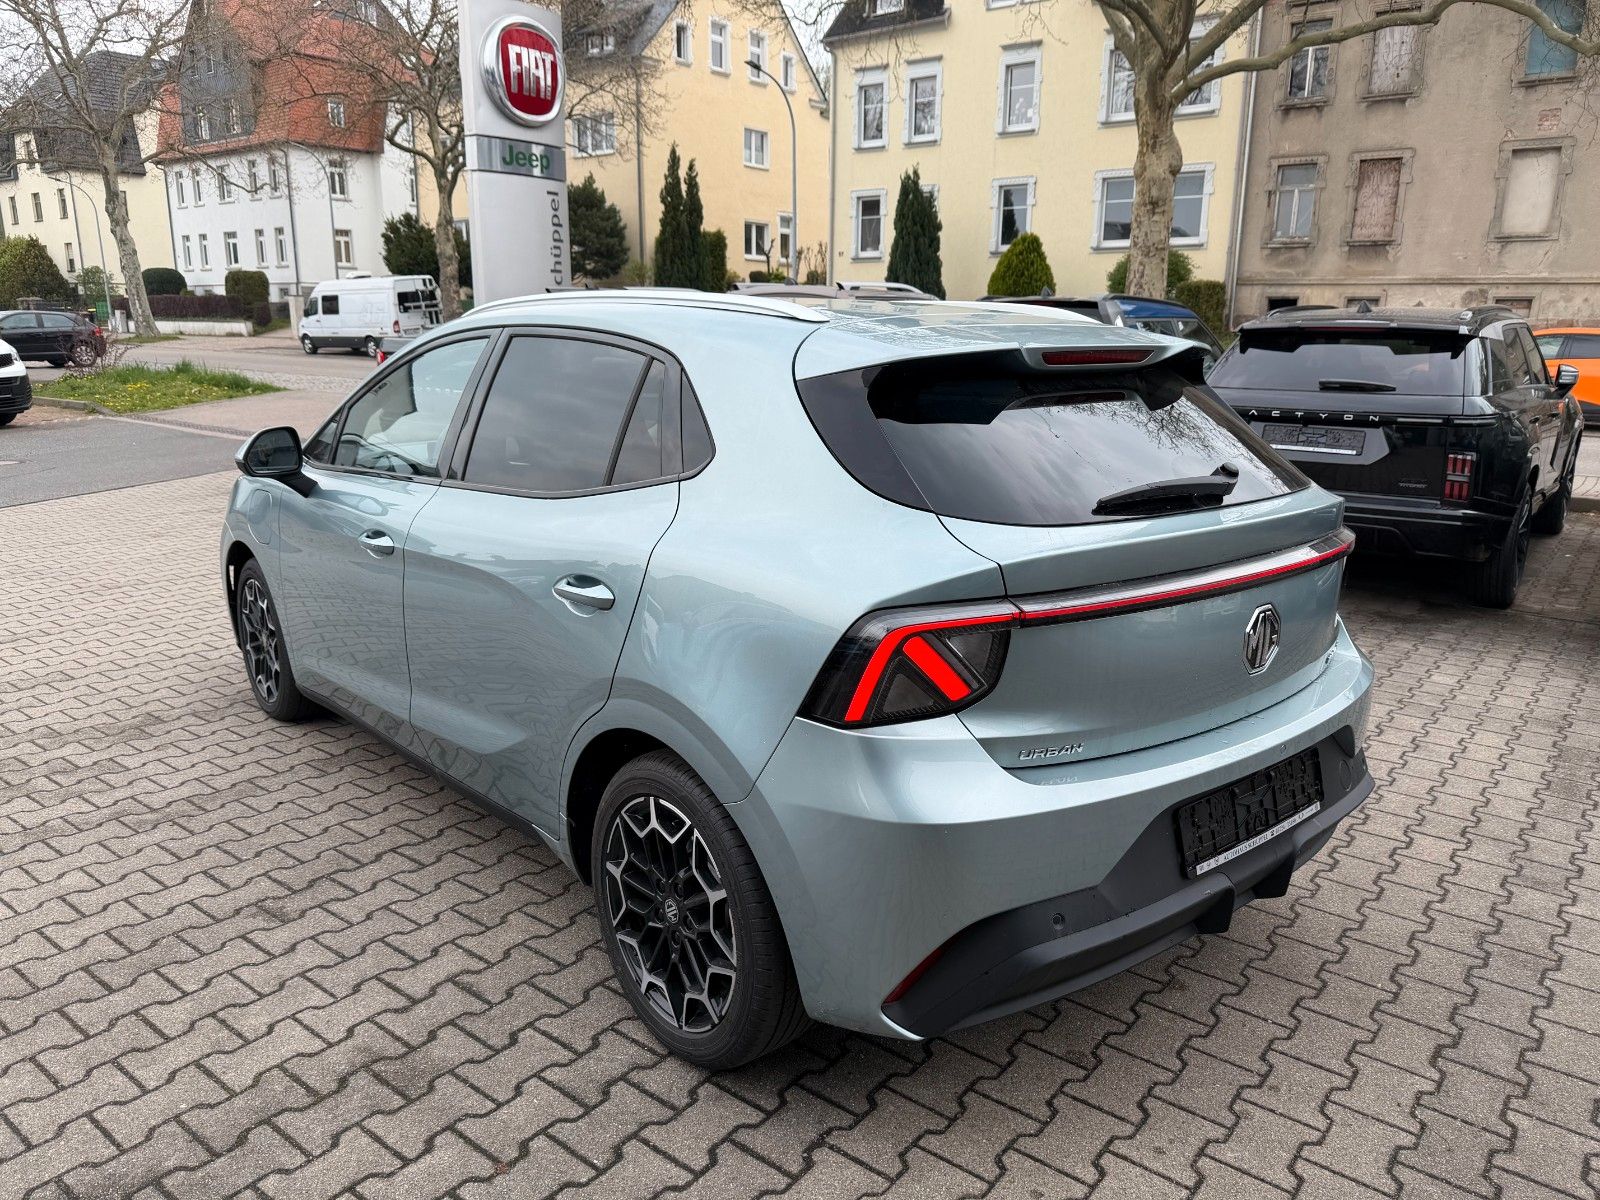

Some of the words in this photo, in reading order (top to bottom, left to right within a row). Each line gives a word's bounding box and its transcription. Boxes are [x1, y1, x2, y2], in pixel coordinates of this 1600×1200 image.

[508, 44, 554, 100] FIAT
[502, 144, 550, 174] Jeep
[547, 190, 563, 285] chüppel
[1249, 410, 1379, 421] ACTYON
[1246, 610, 1278, 668] MG
[1019, 743, 1084, 760] URBAN
